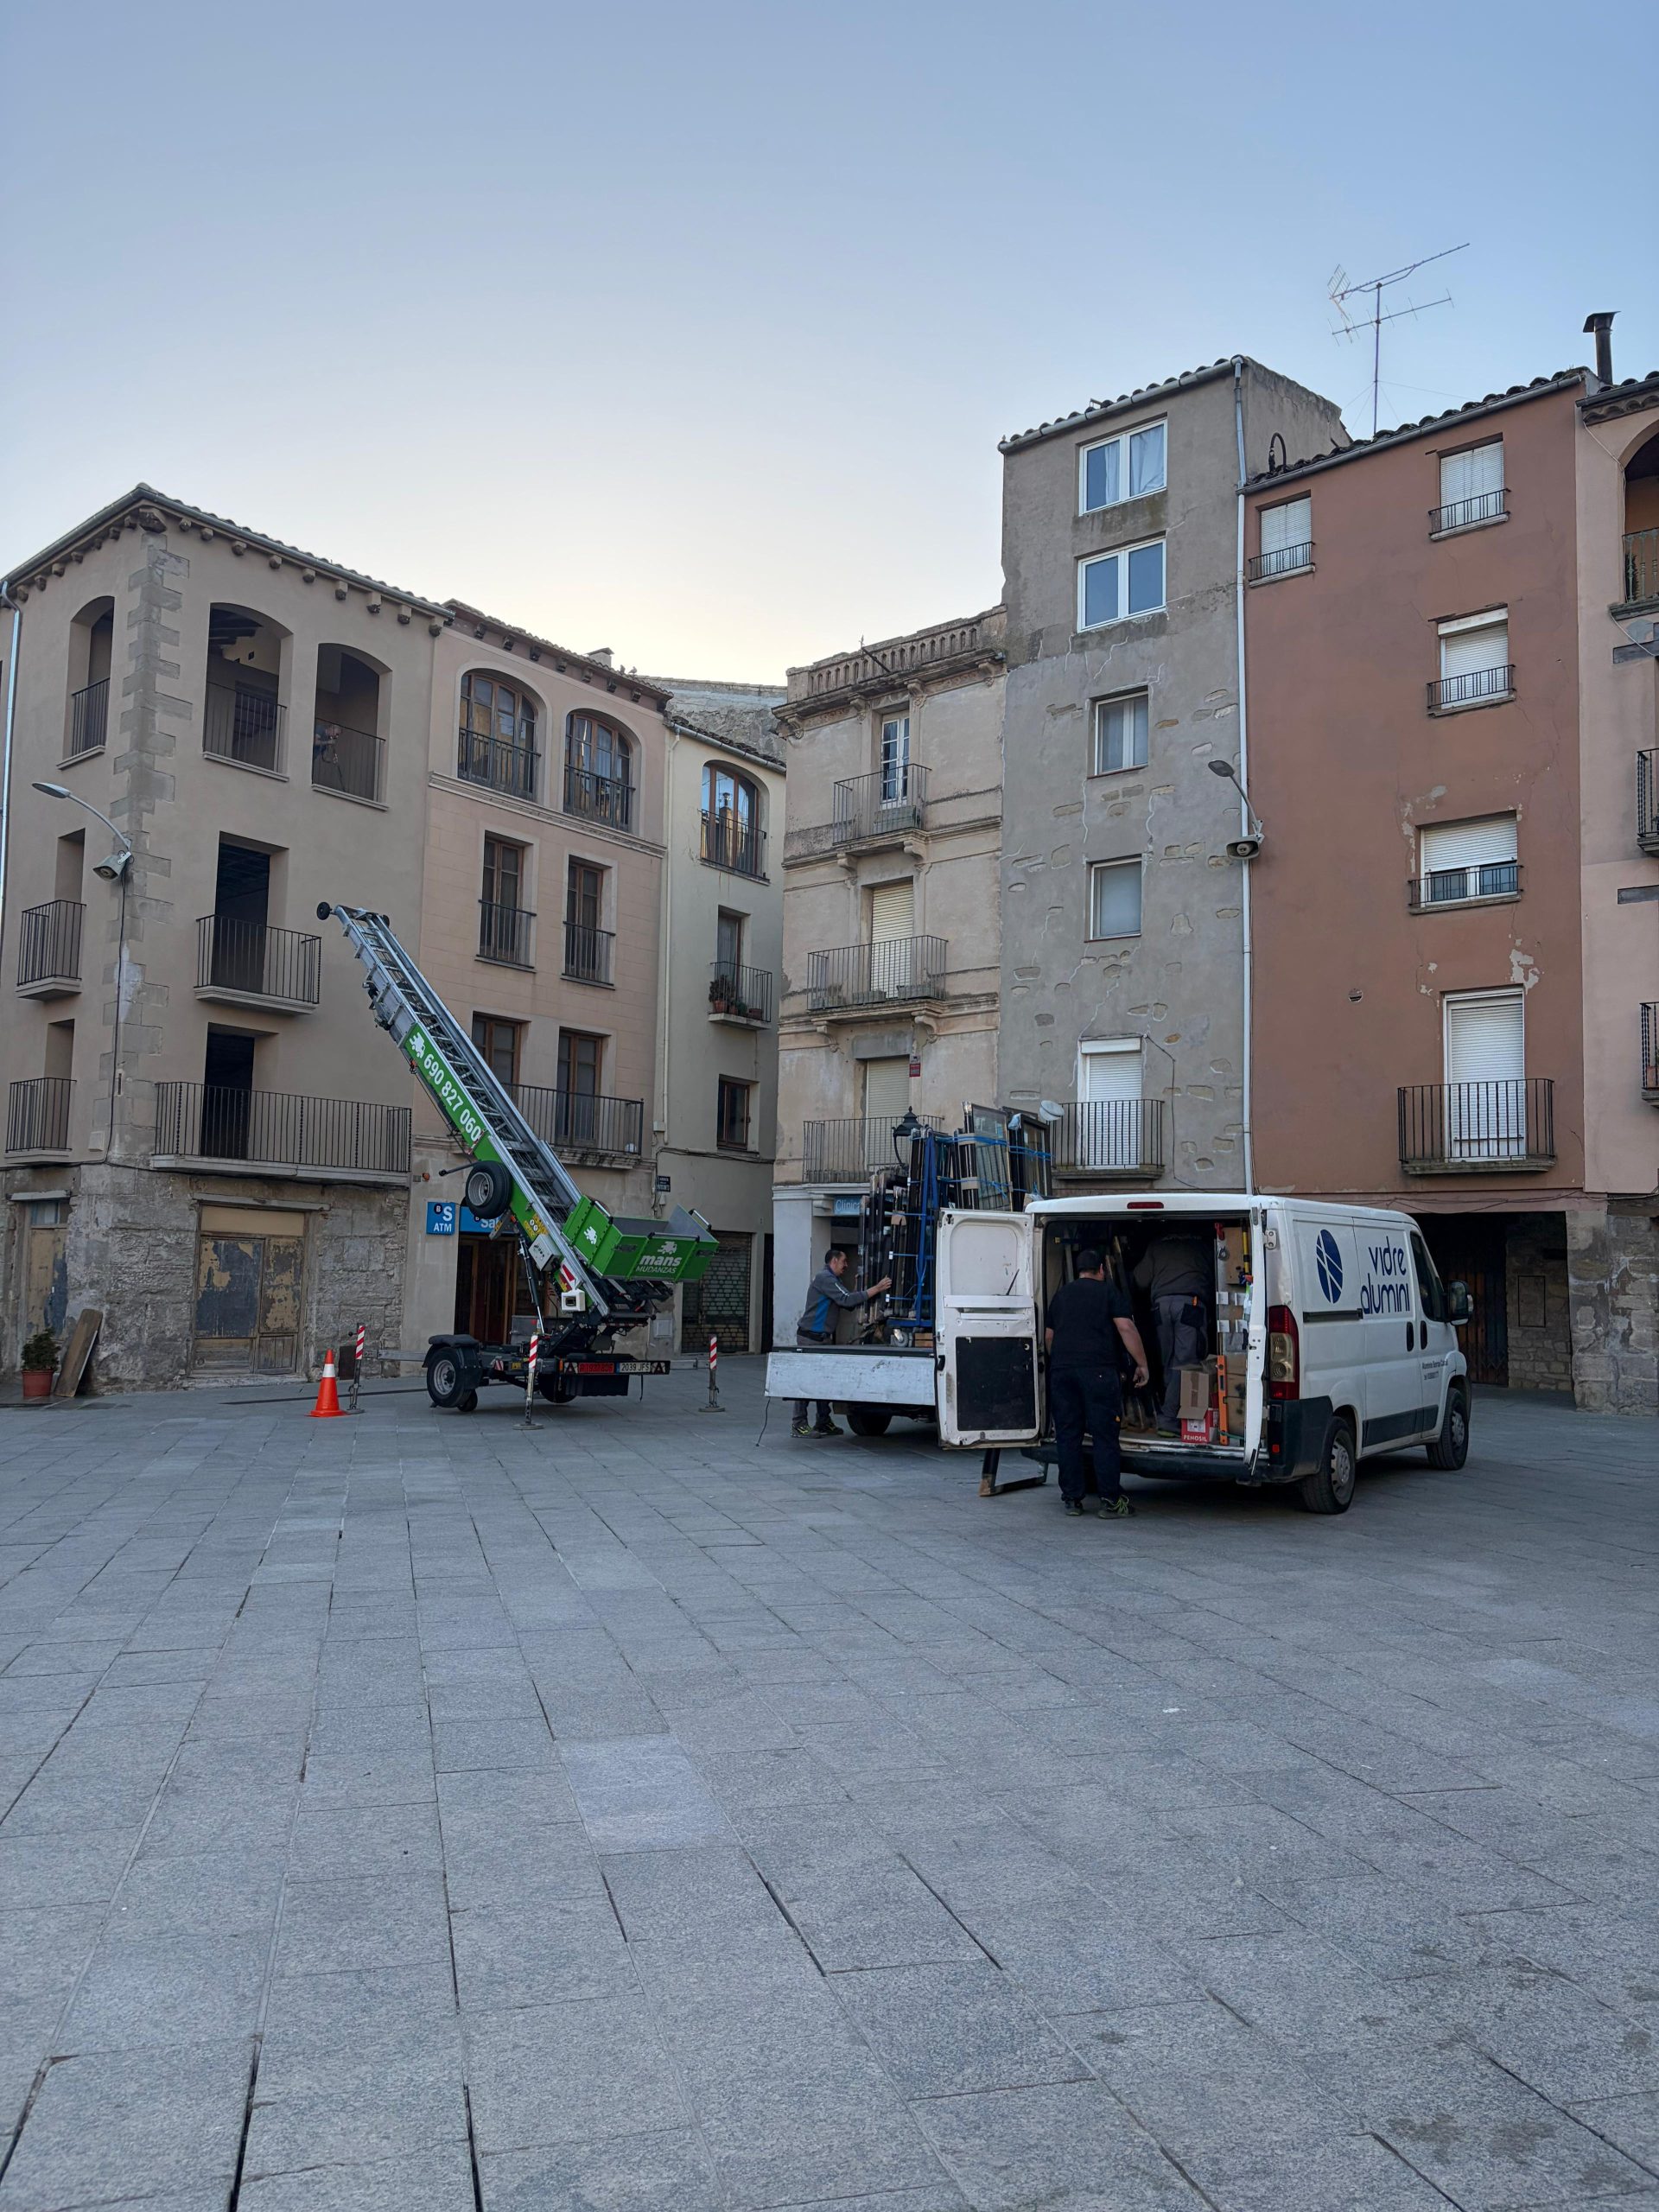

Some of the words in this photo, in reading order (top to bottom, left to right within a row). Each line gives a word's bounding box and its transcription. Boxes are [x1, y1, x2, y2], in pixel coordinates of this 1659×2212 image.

[423, 1053, 444, 1085] 690
[441, 1080, 464, 1113] 827
[459, 1109, 482, 1141] 060
[433, 1222, 452, 1233] ATM
[639, 1255, 683, 1267] mans
[1368, 1236, 1407, 1276] vidre
[1360, 1273, 1410, 1314] alumini
[621, 1363, 637, 1371] 2039
[638, 1363, 650, 1371] JFS
